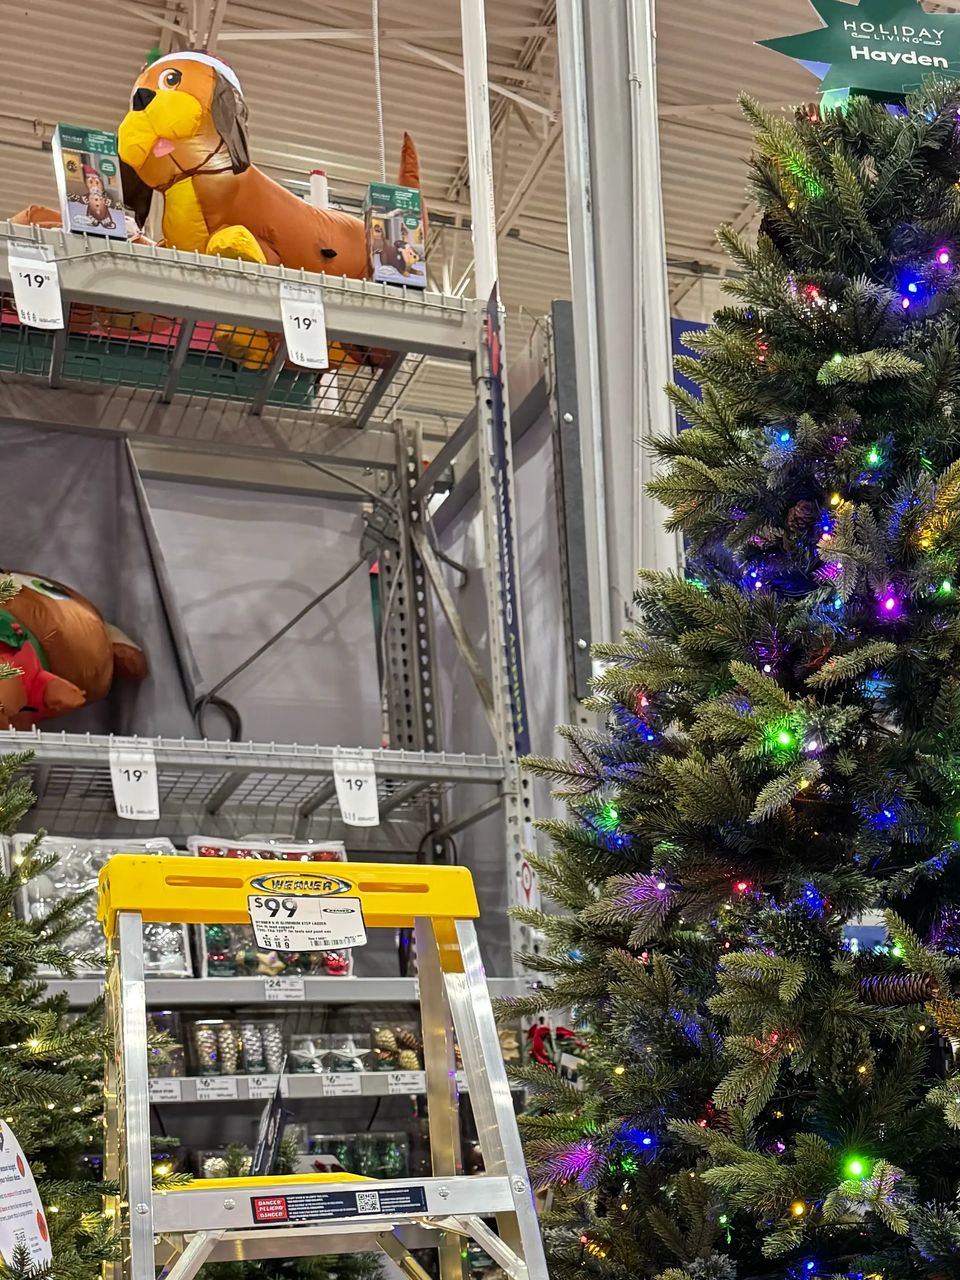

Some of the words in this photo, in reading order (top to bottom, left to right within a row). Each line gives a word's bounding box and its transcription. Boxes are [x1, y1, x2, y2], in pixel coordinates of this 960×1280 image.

[843, 20, 945, 38] HOLIDAY
[873, 34, 922, 44] LIVING
[850, 45, 949, 69] Hayden
[271, 880, 332, 891] WERNER
[254, 897, 298, 918] $99
